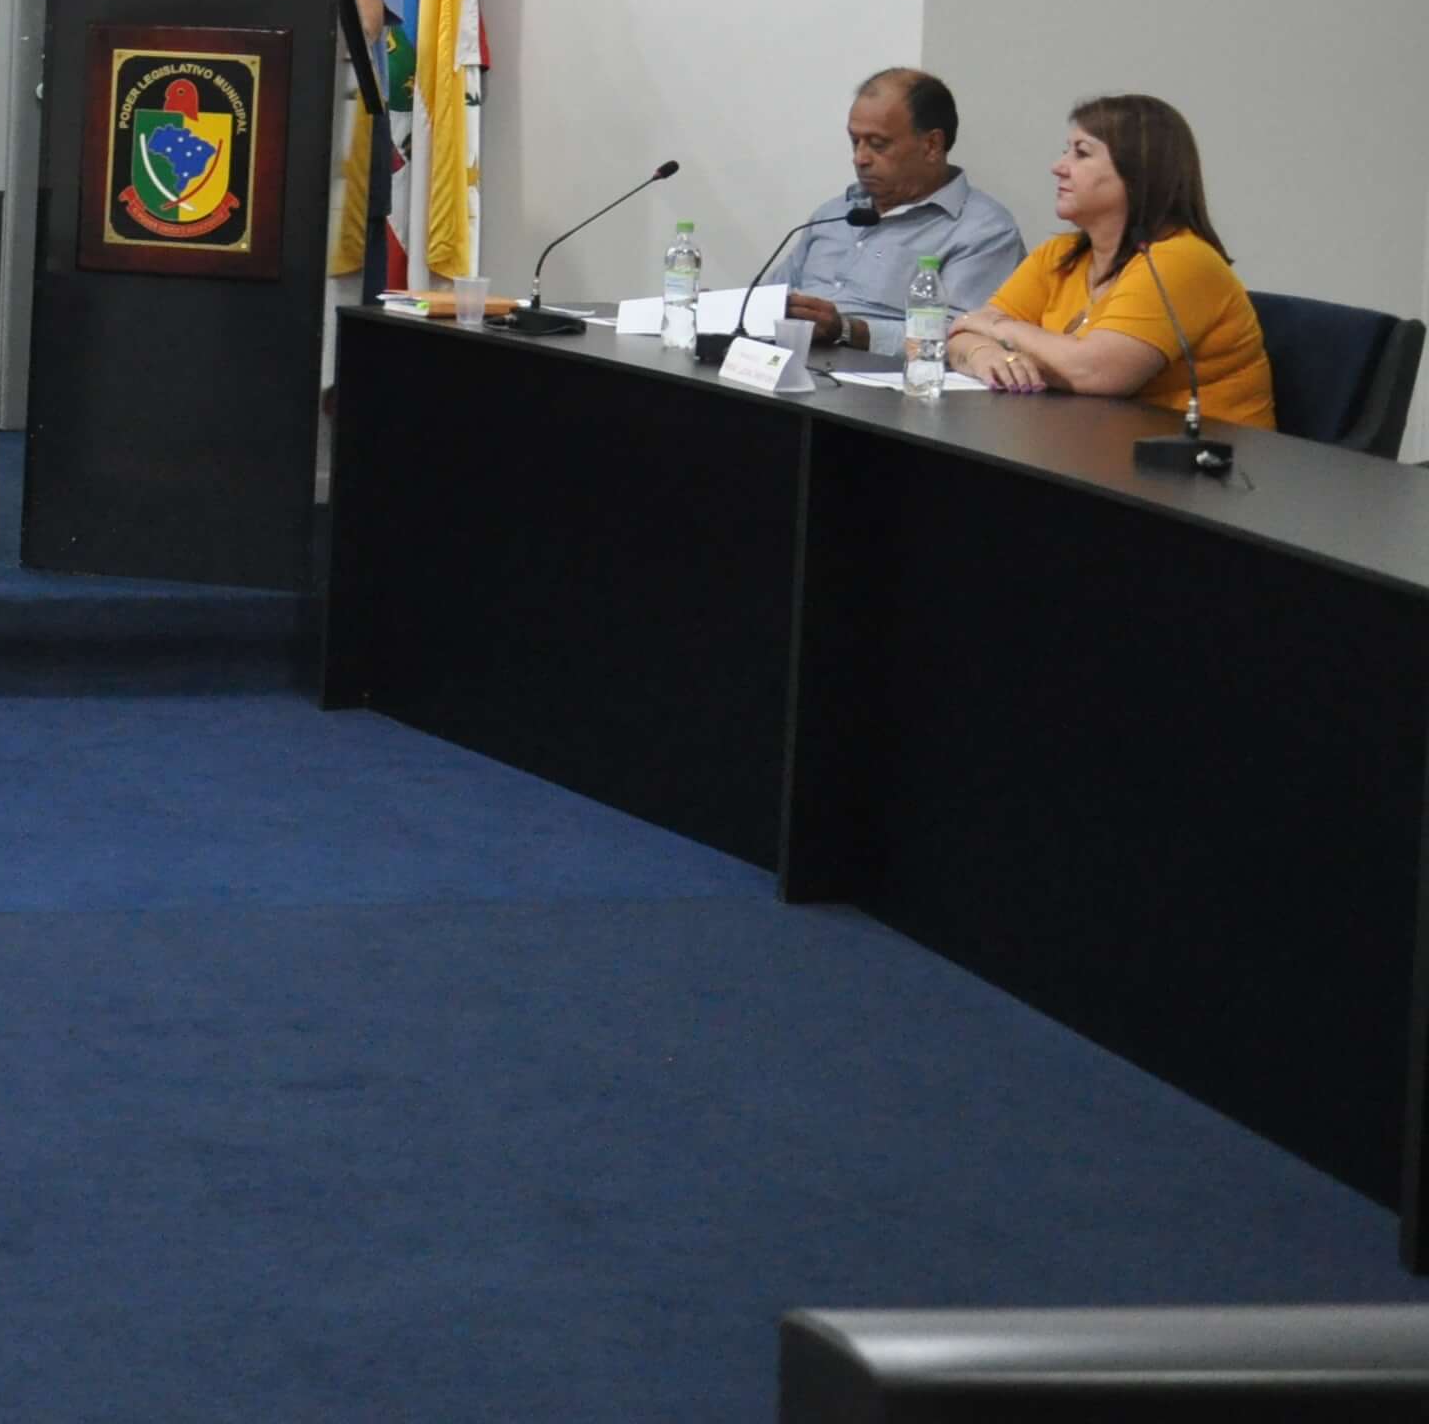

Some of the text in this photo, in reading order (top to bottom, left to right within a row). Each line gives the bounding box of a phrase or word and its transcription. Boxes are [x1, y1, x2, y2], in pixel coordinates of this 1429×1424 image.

[119, 63, 247, 135] PODER LEGISLATIVO MUNICIPAL
